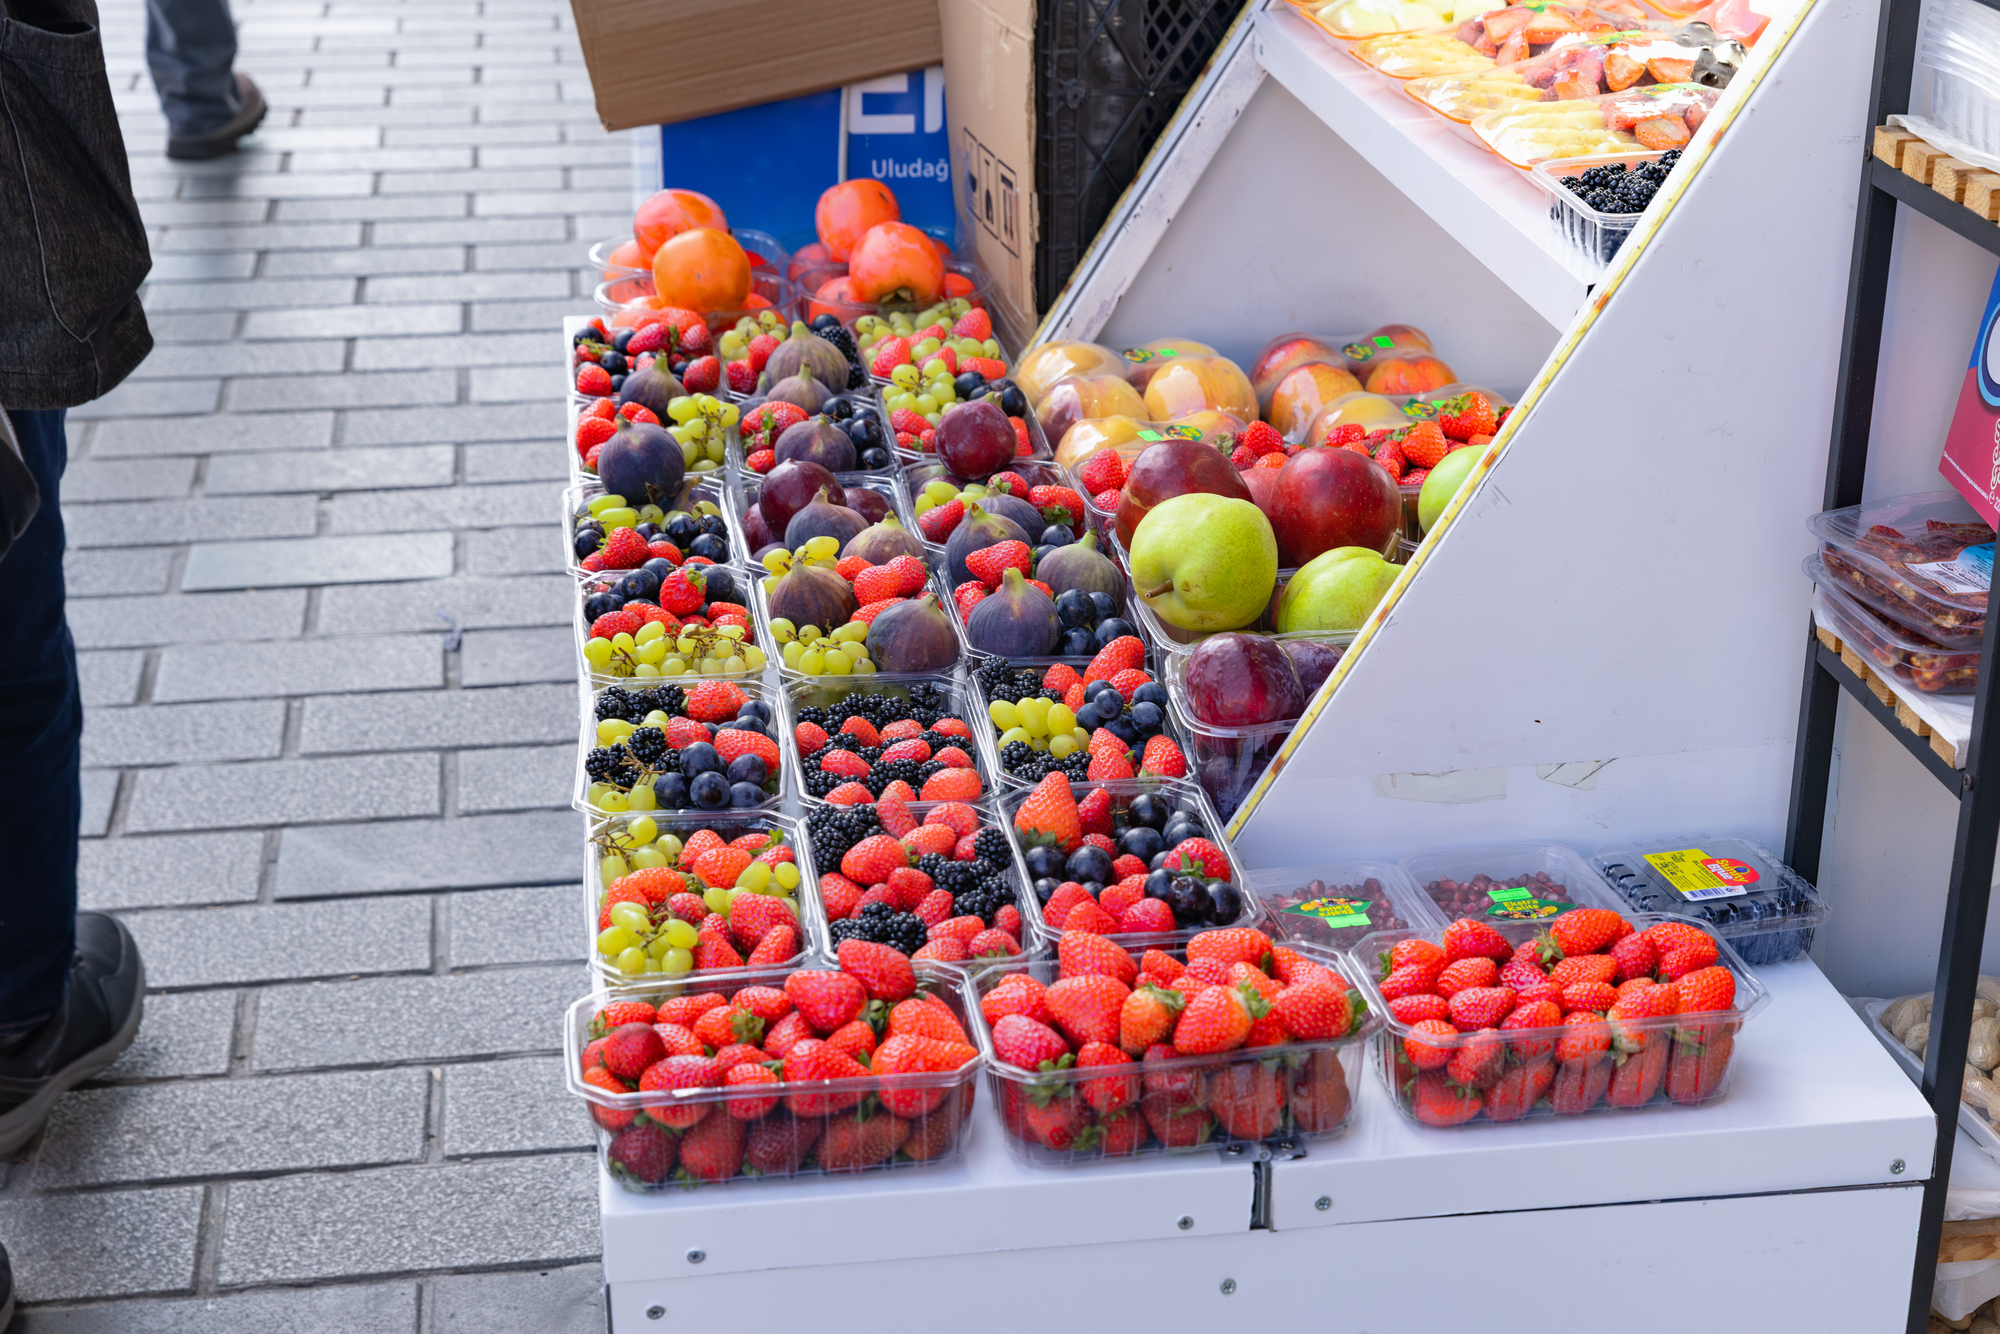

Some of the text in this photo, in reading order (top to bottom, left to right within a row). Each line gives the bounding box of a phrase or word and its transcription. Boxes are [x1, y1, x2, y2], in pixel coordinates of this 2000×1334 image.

[871, 157, 949, 183] Uludağ
[1706, 863, 1734, 881] Blue
[1715, 859, 1749, 883] Sunny
[1318, 904, 1352, 912] Kalite
[1502, 899, 1539, 908] Ekstra
[1506, 904, 1540, 912] Kalite
[1318, 908, 1356, 917] Ekstra
